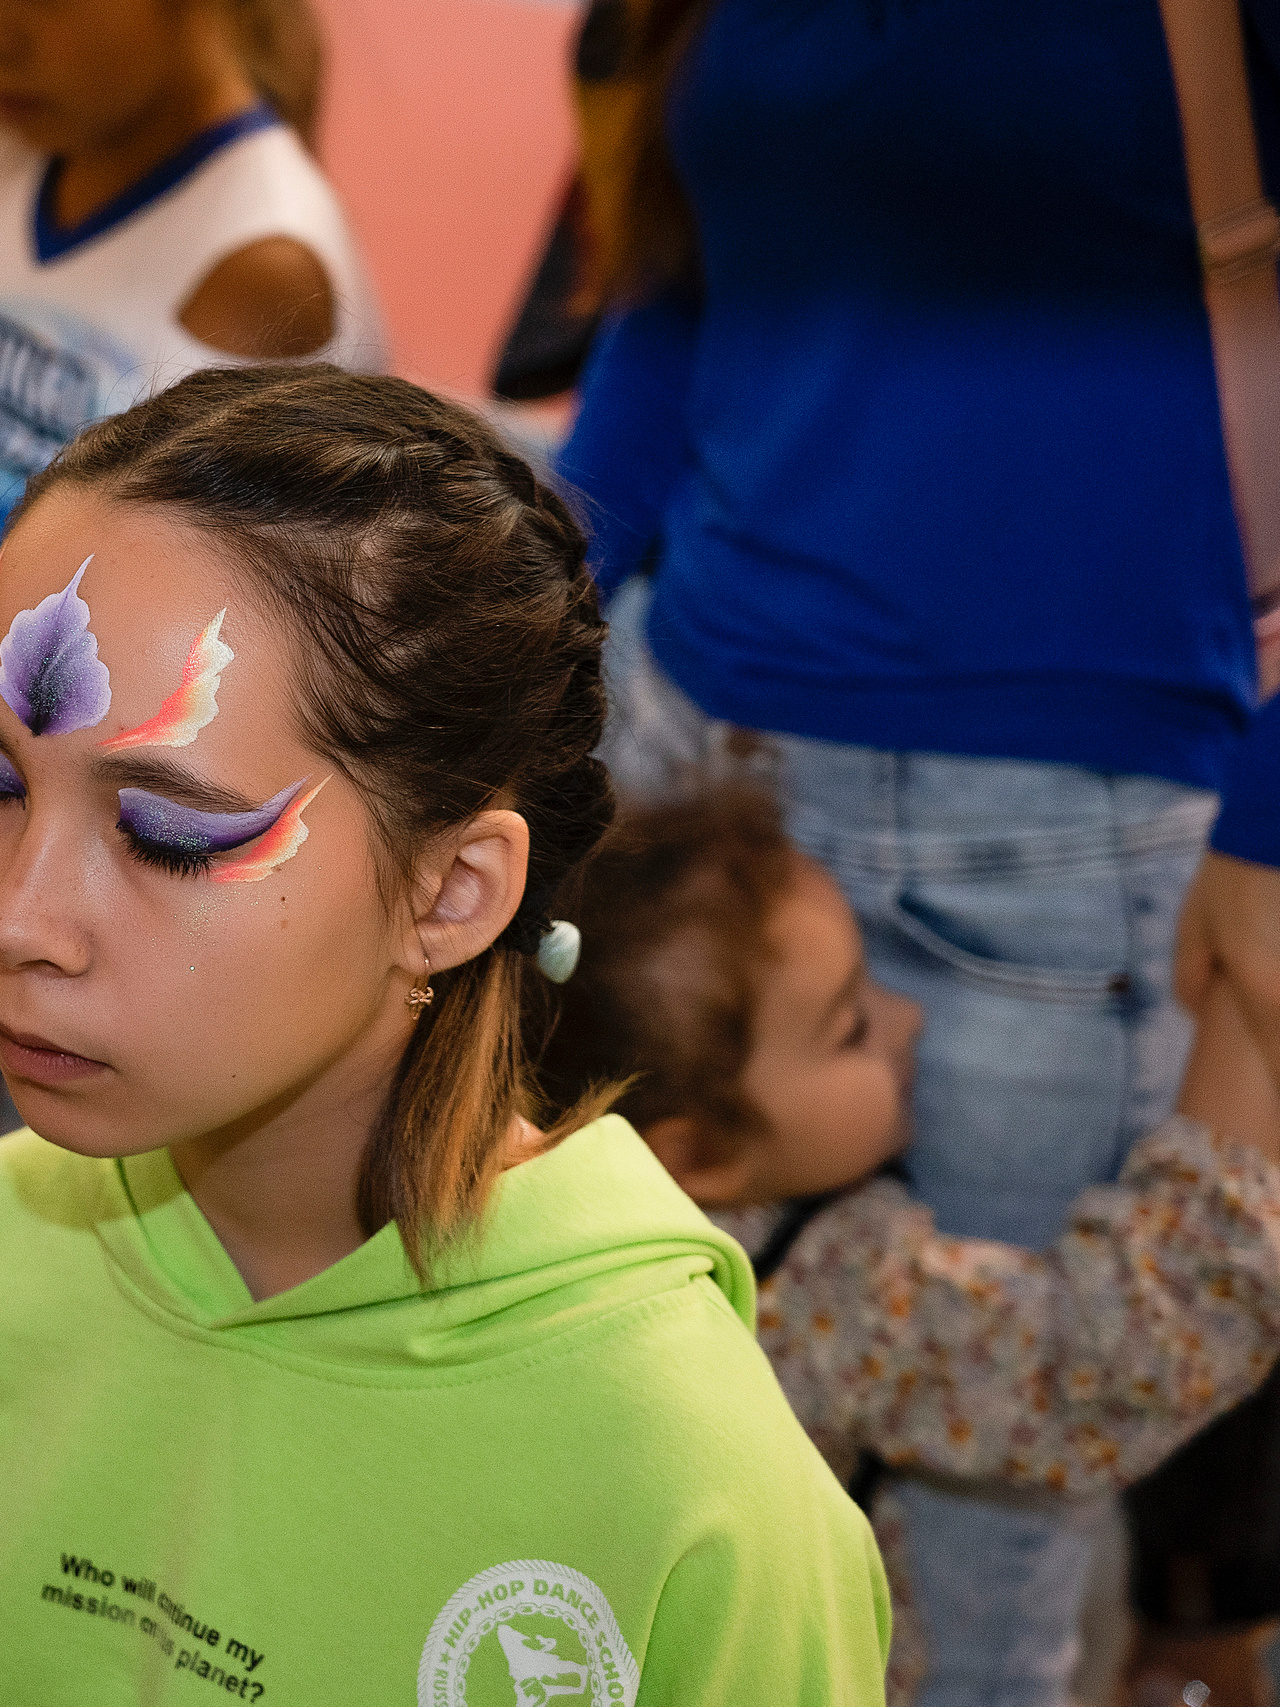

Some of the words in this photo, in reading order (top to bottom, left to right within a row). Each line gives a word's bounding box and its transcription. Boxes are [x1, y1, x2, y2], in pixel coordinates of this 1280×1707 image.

[41, 1583, 137, 1627] mission
[175, 1650, 266, 1704] planet?
[60, 1552, 117, 1588] Who
[225, 1637, 265, 1672] my
[443, 1579, 525, 1649] HIP-HOP
[533, 1578, 600, 1630] DANCE
